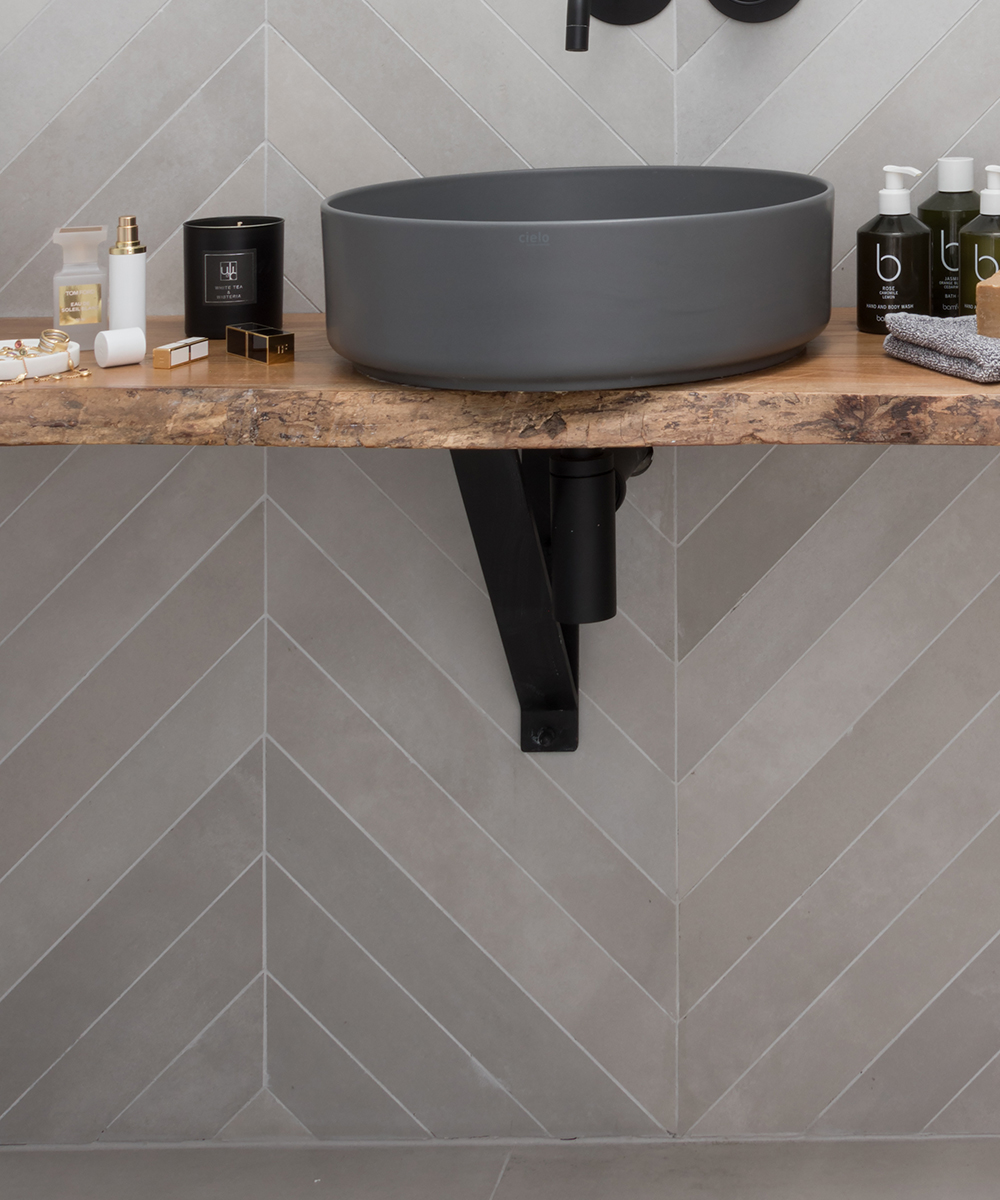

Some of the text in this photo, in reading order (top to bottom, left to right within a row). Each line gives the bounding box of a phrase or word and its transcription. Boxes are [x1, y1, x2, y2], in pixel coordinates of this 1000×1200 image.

[519, 231, 550, 244] cielo
[876, 243, 901, 282] b
[974, 243, 999, 281] b
